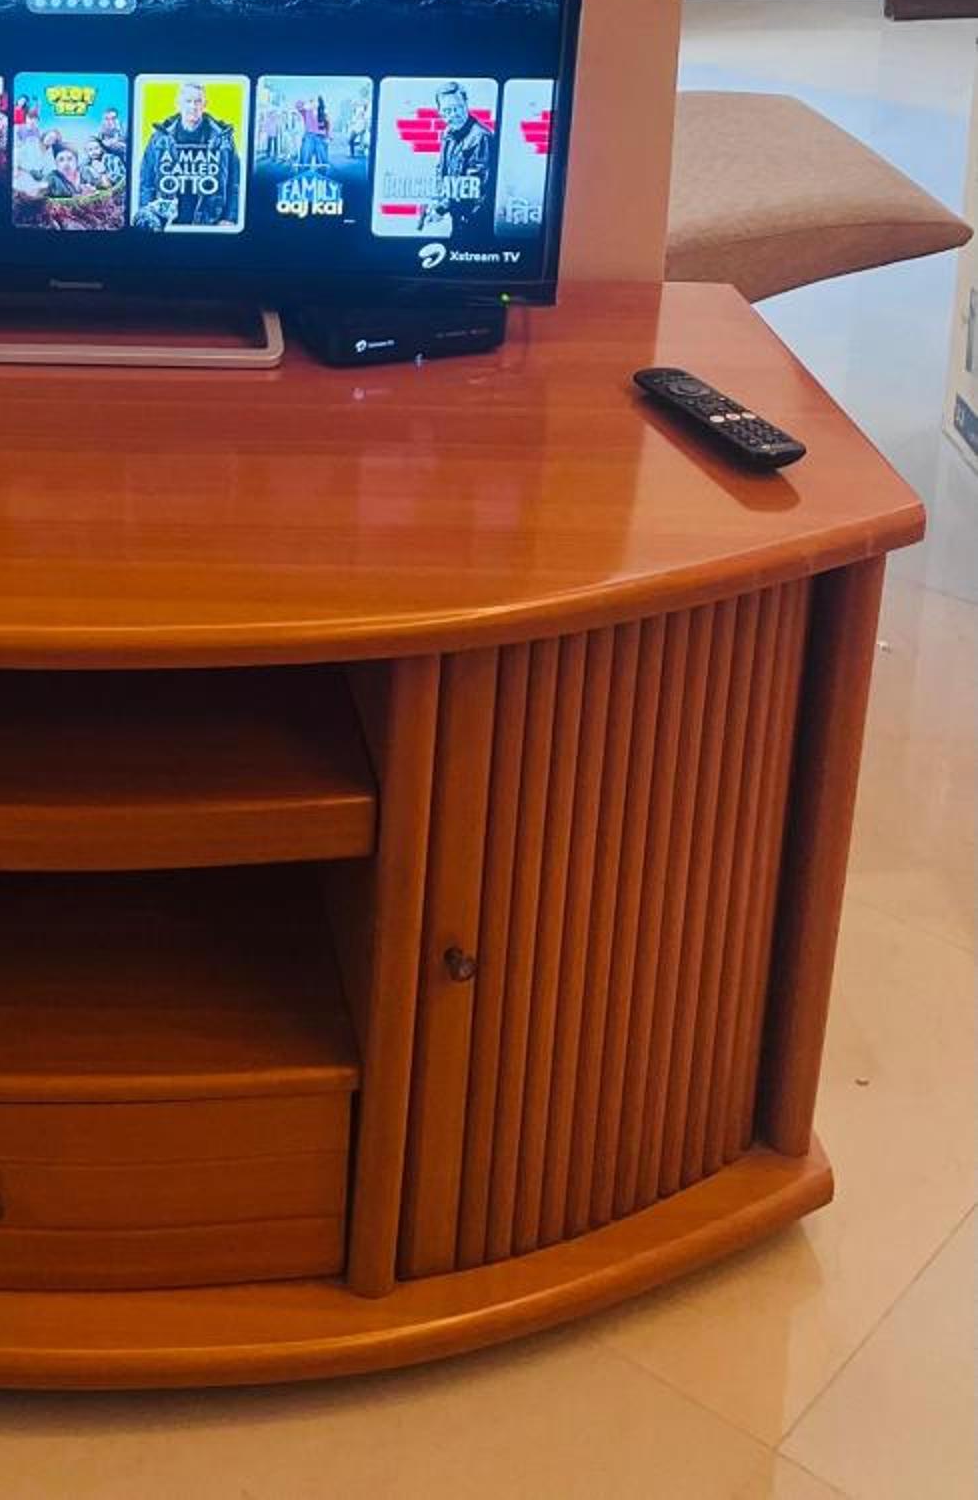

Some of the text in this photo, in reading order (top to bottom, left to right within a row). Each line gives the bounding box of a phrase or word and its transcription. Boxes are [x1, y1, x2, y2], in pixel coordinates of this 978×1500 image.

[160, 149, 221, 163] A MAN
[159, 163, 220, 176] CALLED
[159, 175, 219, 195] OTTO
[281, 176, 340, 201] FAMILY
[275, 198, 343, 218] aaj kal
[449, 250, 521, 263] Xstream TV
